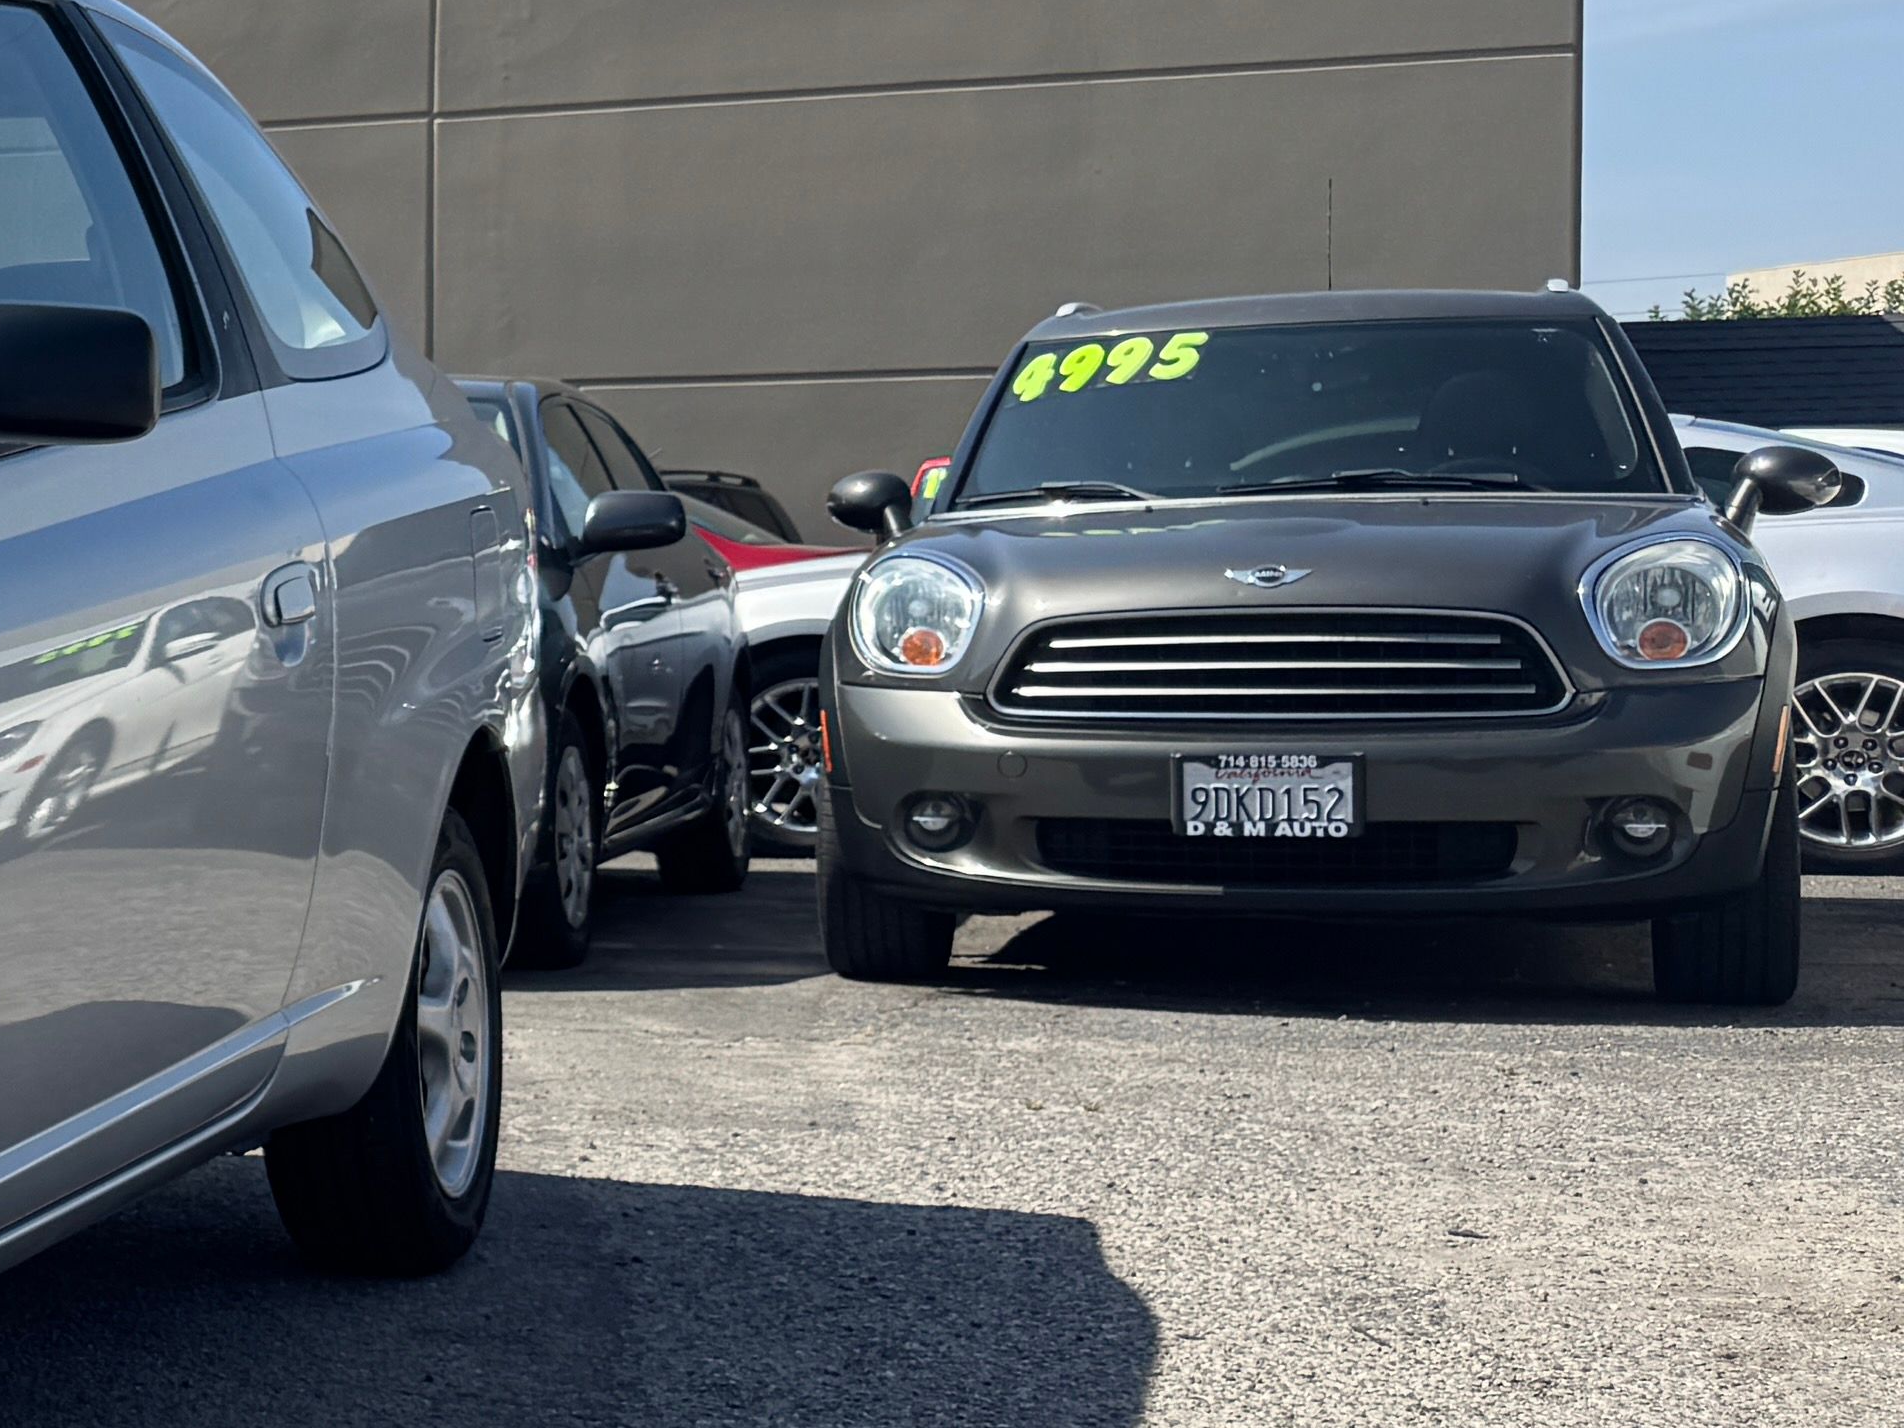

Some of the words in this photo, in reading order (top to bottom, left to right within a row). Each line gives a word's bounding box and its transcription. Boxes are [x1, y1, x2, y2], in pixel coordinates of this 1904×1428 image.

[1012, 332, 1209, 403] 4995
[1191, 784, 1345, 822] 9DKD152
[1186, 821, 1205, 836] D
[1213, 821, 1235, 836] &
[1243, 821, 1266, 837] M
[1274, 821, 1349, 837] AUTO
